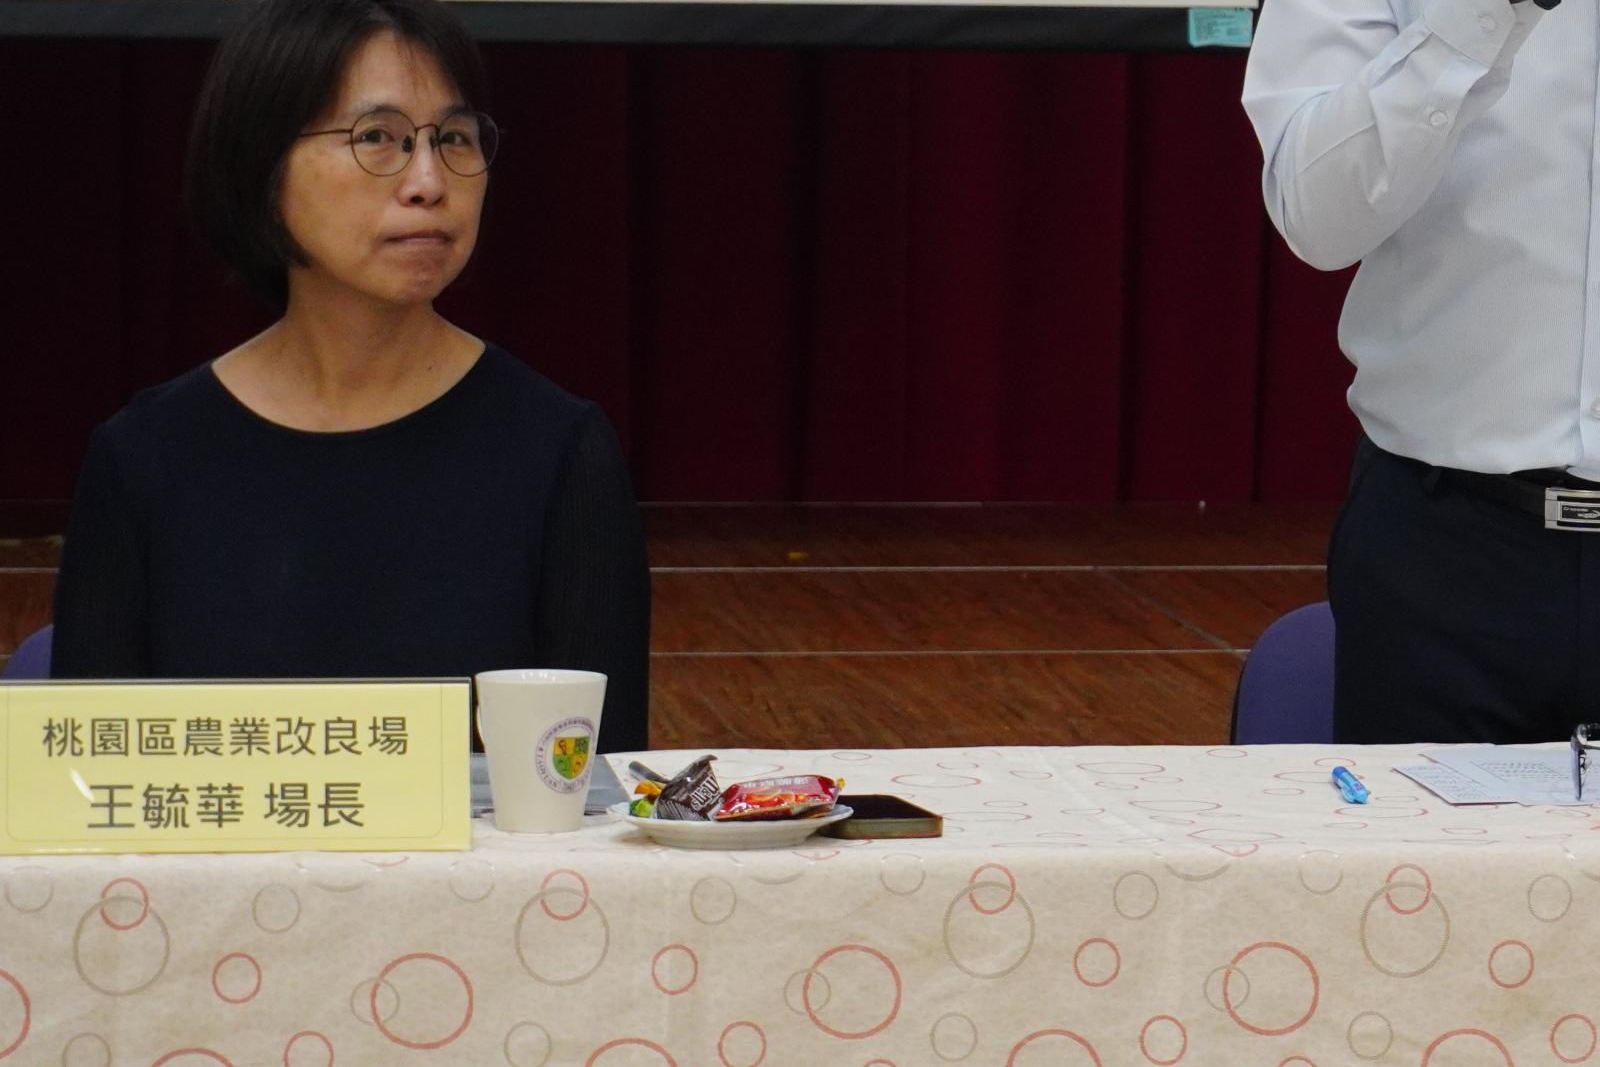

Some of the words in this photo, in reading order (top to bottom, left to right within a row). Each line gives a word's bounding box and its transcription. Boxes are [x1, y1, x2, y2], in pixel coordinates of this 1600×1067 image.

[42, 716, 408, 757] 桃園區農業改良場
[88, 783, 244, 829] 王毓華
[264, 782, 364, 828] 場長
